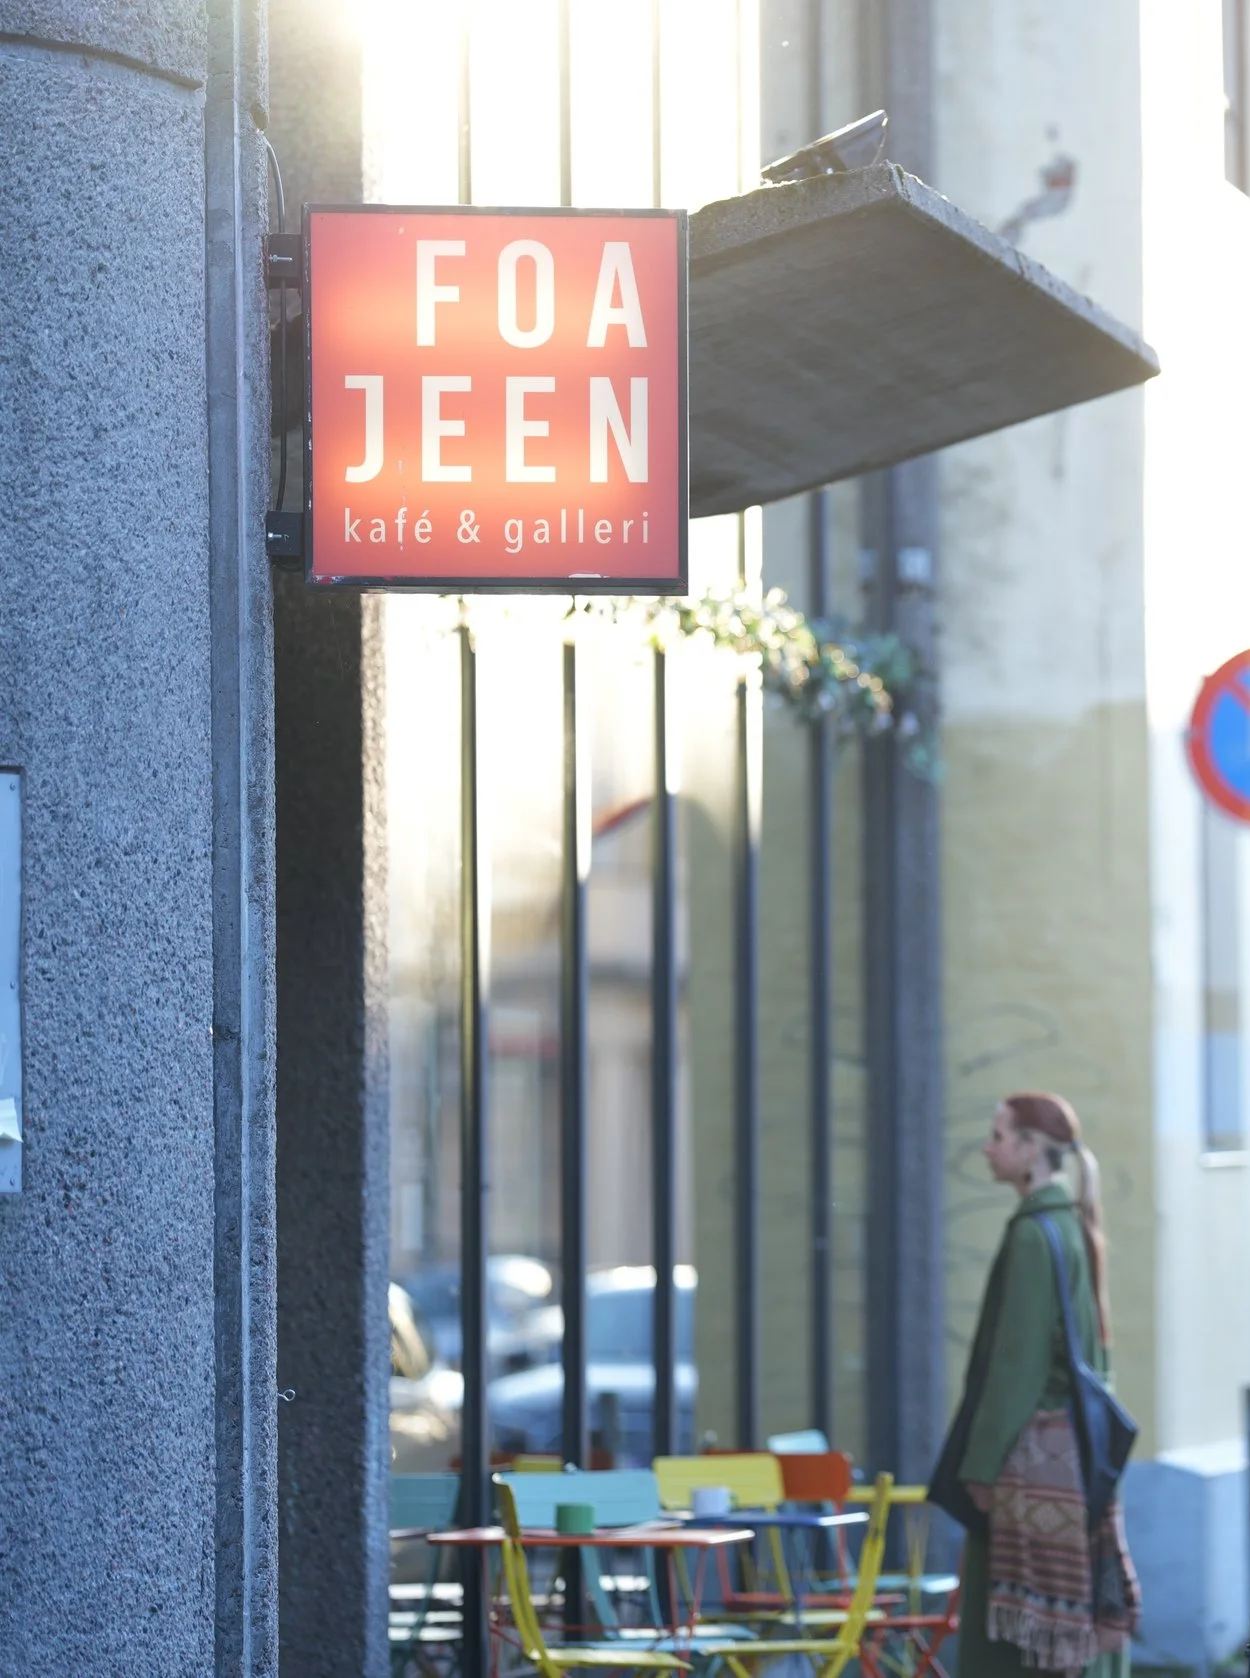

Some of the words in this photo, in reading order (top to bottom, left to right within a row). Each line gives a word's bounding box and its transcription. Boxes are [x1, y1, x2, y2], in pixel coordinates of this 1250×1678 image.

[416, 239, 648, 348] FOA
[344, 375, 649, 483] JEEN
[344, 507, 433, 544] kafé
[456, 509, 481, 543] &
[504, 508, 650, 553] galleri
